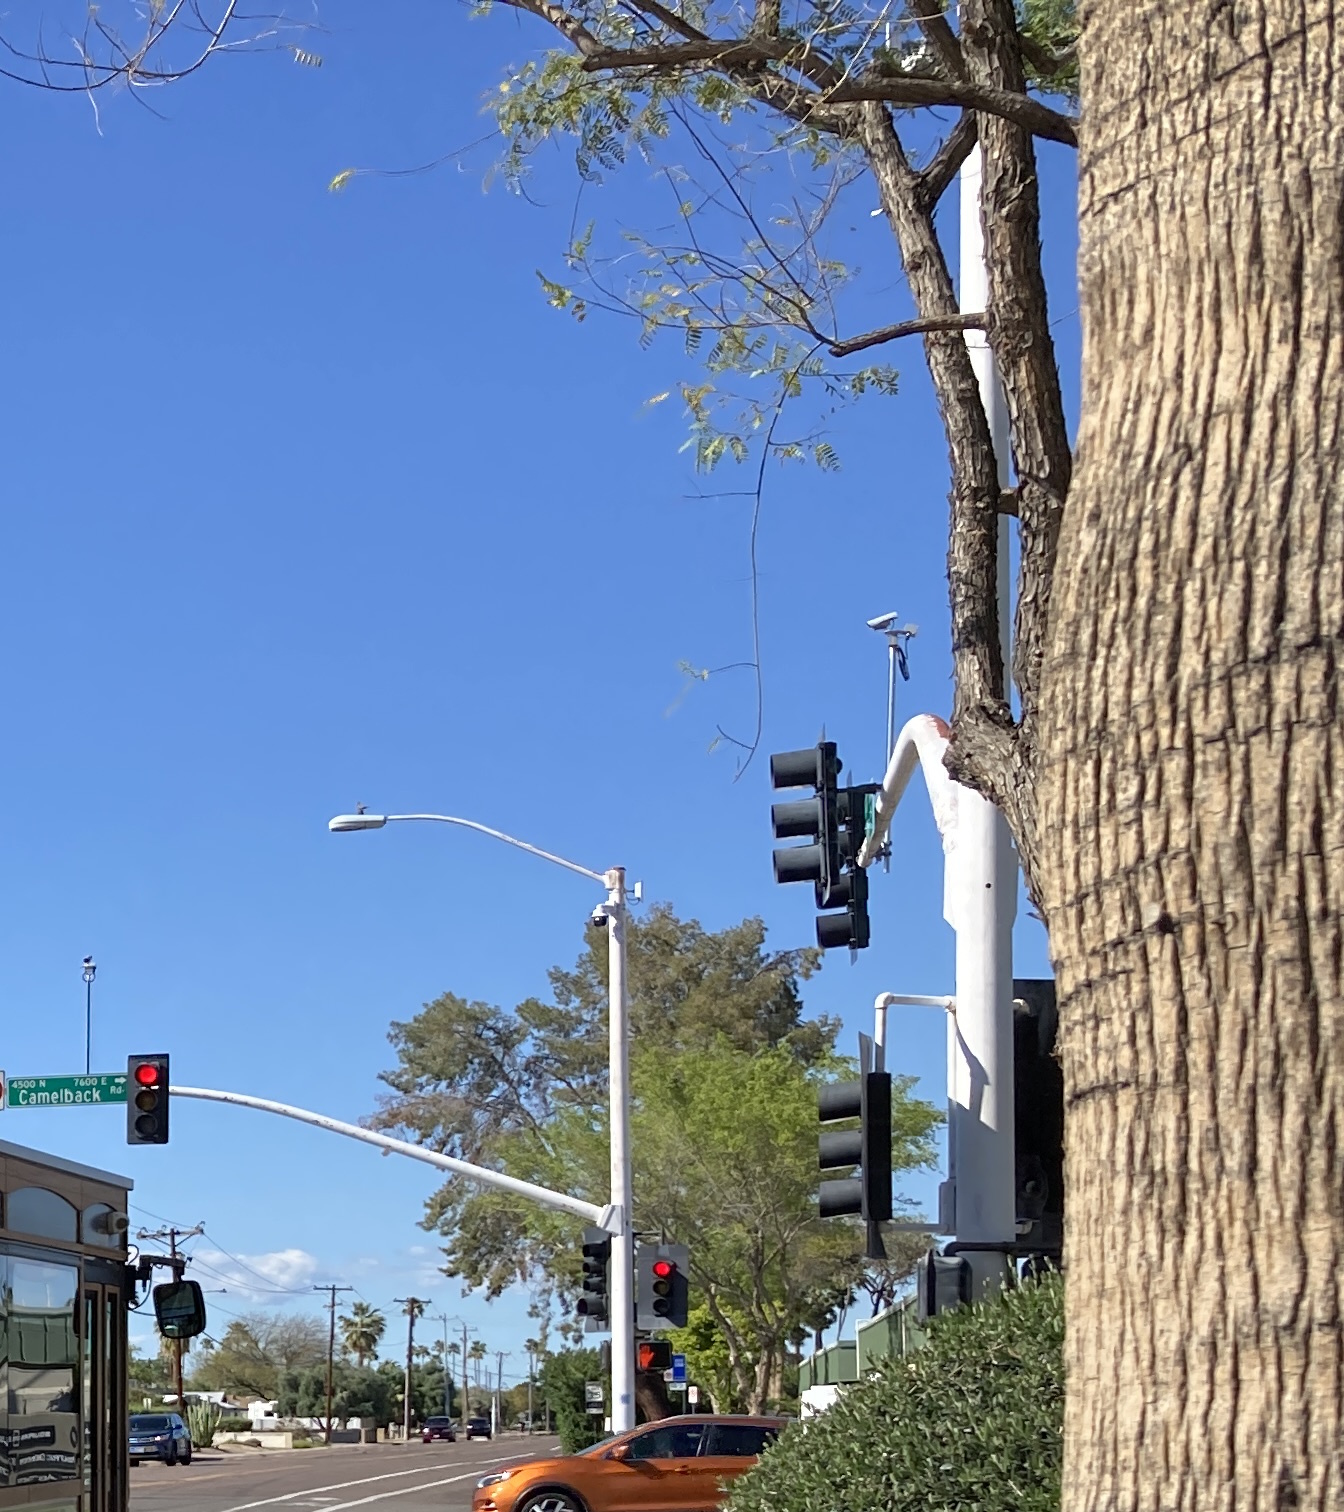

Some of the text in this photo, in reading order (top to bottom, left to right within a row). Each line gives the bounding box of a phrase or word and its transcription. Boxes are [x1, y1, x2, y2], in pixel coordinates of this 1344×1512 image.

[12, 1076, 108, 1089] 4500 N 7600 E
[18, 1087, 102, 1105] Camelback
